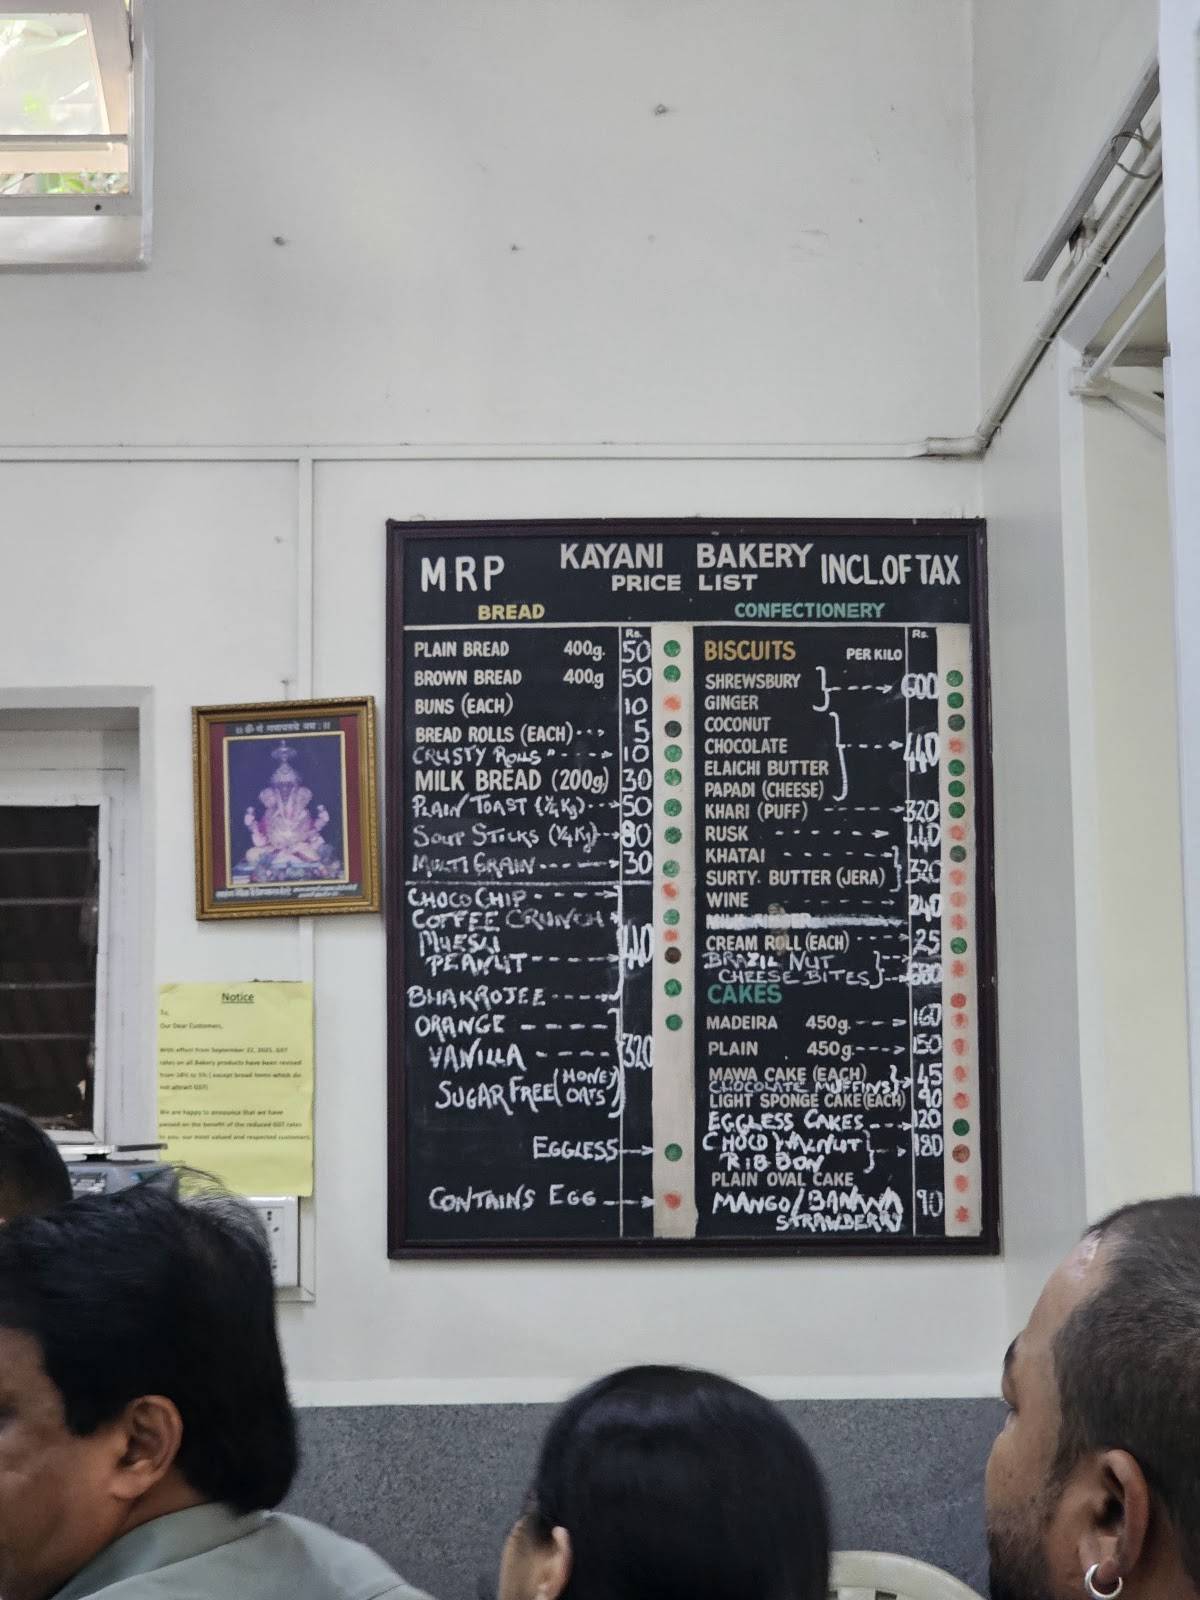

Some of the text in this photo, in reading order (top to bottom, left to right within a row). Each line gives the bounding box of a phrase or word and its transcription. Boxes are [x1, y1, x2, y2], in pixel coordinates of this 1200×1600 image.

[561, 543, 813, 569] KAYANI BAKERY
[915, 554, 961, 585] TAX
[611, 574, 758, 591] PRICE LIST
[478, 604, 545, 621] BREAD
[734, 602, 885, 618] CONFECTIONERY
[414, 642, 457, 658] PLAIN
[463, 641, 509, 657] BREAD
[622, 641, 651, 663] 50
[704, 640, 902, 661] BISCUITS PER KILO
[414, 669, 467, 686] BROWN
[474, 669, 522, 685] BREAD
[622, 667, 652, 688] 50
[705, 673, 938, 700] SHREWSBURY 600
[415, 692, 648, 718] BUNS (EACH) 10
[704, 695, 758, 710] GINGER
[415, 719, 650, 747] BREAD ROLLS (EACH) 5
[704, 716, 771, 732] COCONUT
[412, 747, 486, 766] CRUSTY
[623, 745, 649, 763] 10
[704, 738, 788, 754] CHOCOLATE
[704, 760, 828, 776] ELAICHI BUTTER
[415, 769, 465, 792] MILK
[475, 769, 542, 791] BREAD
[623, 768, 652, 792] 30
[705, 780, 825, 801] PAPADI (CHEESE)
[469, 794, 527, 816] TOAST
[621, 798, 652, 818] 50
[705, 800, 939, 823] KHARI (PUFF) 320
[620, 820, 651, 847] 80
[705, 826, 749, 841] RUSK
[624, 851, 652, 874] 30
[705, 848, 765, 863] KHATAI
[769, 869, 831, 886] BUTTER
[836, 867, 886, 888] (JERA)
[408, 887, 527, 908] CHOCO CHIP
[706, 892, 749, 908] WINE
[412, 909, 500, 932] COFFEE
[706, 929, 940, 955] CREAM ROLL (EACH) 25
[789, 951, 835, 972] NUT
[719, 968, 801, 984] CHEESE
[803, 968, 870, 986] BITES
[222, 992, 255, 1002] Notice
[707, 984, 783, 1004] CAKES
[415, 1014, 506, 1042] ORANGE
[706, 1015, 778, 1030] MADEIRA
[429, 1038, 527, 1072] VANILLA
[708, 1041, 758, 1055] PLAIN
[709, 1063, 867, 1083] MAWA CAKE (EACH)
[709, 1081, 809, 1094] CHOCOLATE
[710, 1093, 753, 1109] LIGHT
[760, 1093, 820, 1109] SPONGE
[824, 1093, 862, 1109] CAKE
[863, 1093, 906, 1111] (EACH)
[708, 1112, 794, 1134] EGGLESS
[803, 1109, 864, 1131] CAKES
[533, 1135, 619, 1162] EGGLESS
[712, 1172, 854, 1187] PLAIN OVAL CAKE
[429, 1184, 596, 1212] CONTAINS EGG
